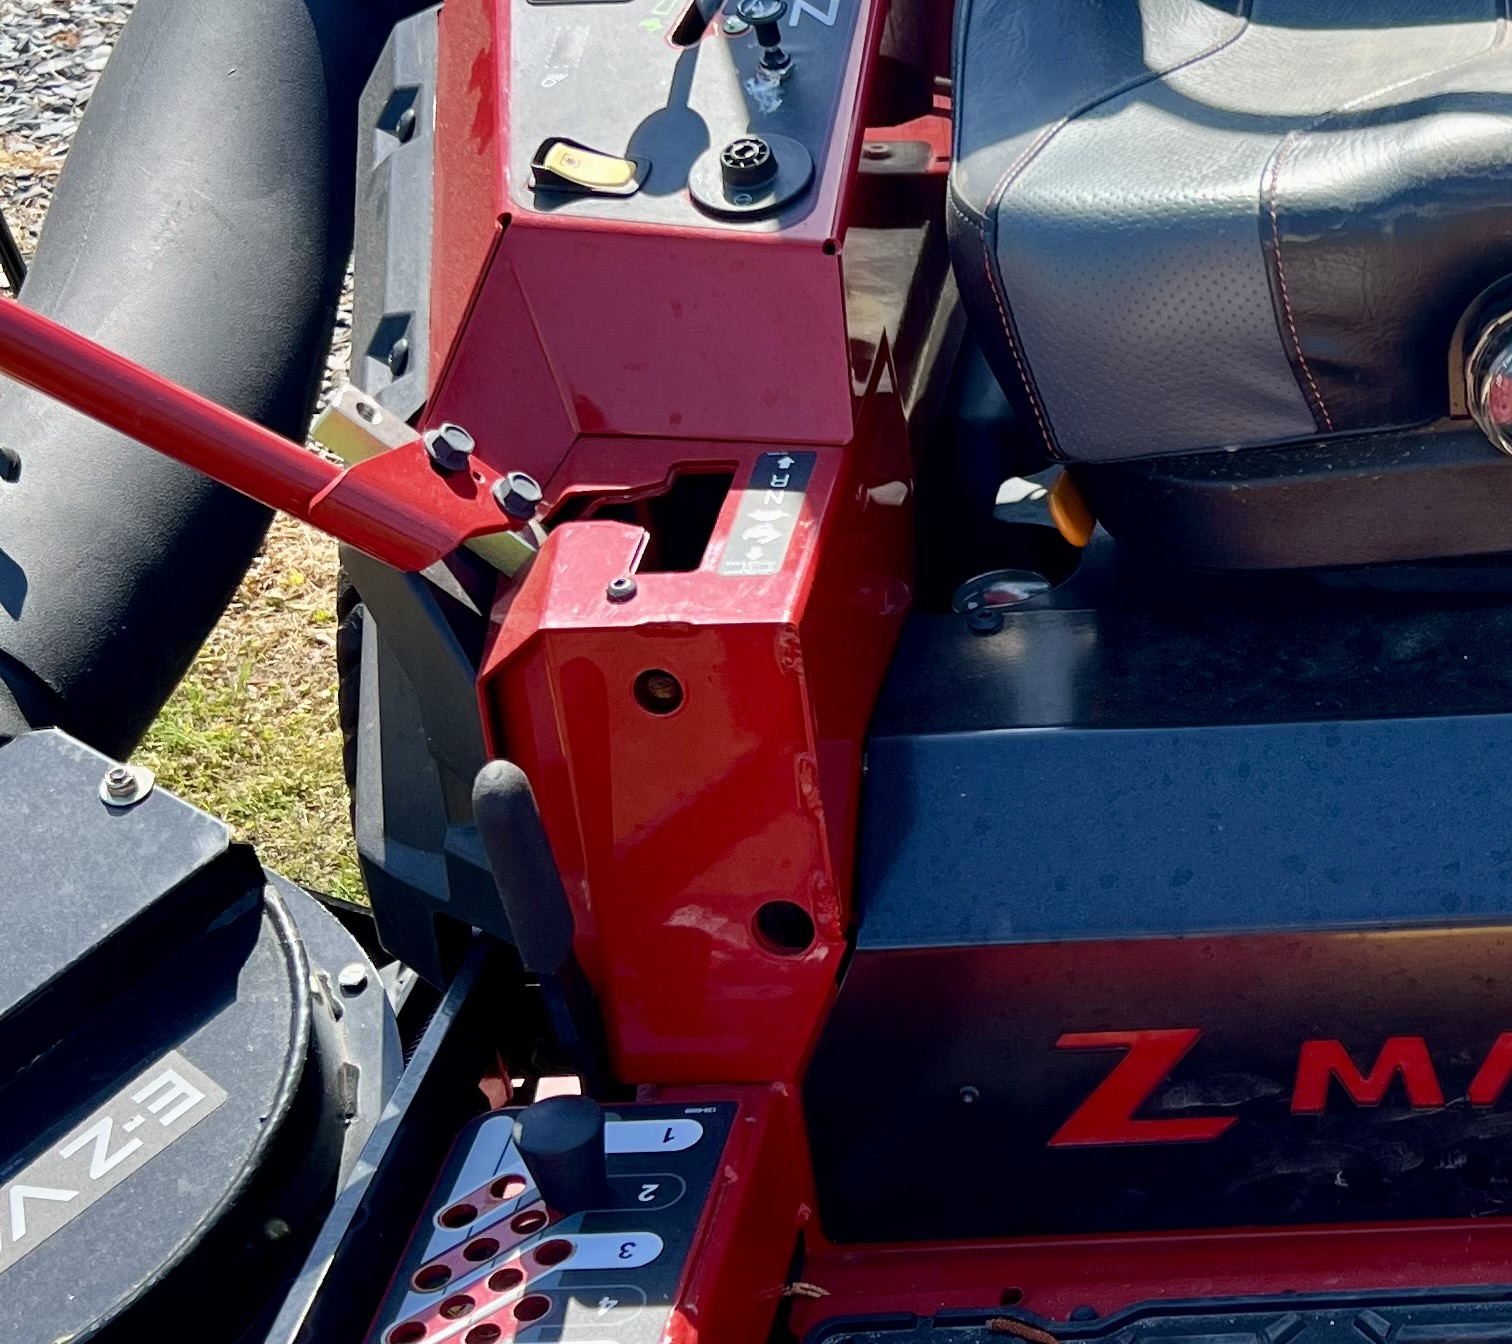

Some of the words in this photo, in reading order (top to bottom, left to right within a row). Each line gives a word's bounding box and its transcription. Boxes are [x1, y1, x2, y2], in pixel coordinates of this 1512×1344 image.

[1047, 1028, 1236, 1147] Z
[58, 1068, 206, 1181] E-Z
[662, 1127, 676, 1144] 1
[637, 1183, 660, 1202] 2
[0, 1184, 80, 1253] V
[618, 1241, 637, 1259] 3
[597, 1296, 620, 1316] 4
